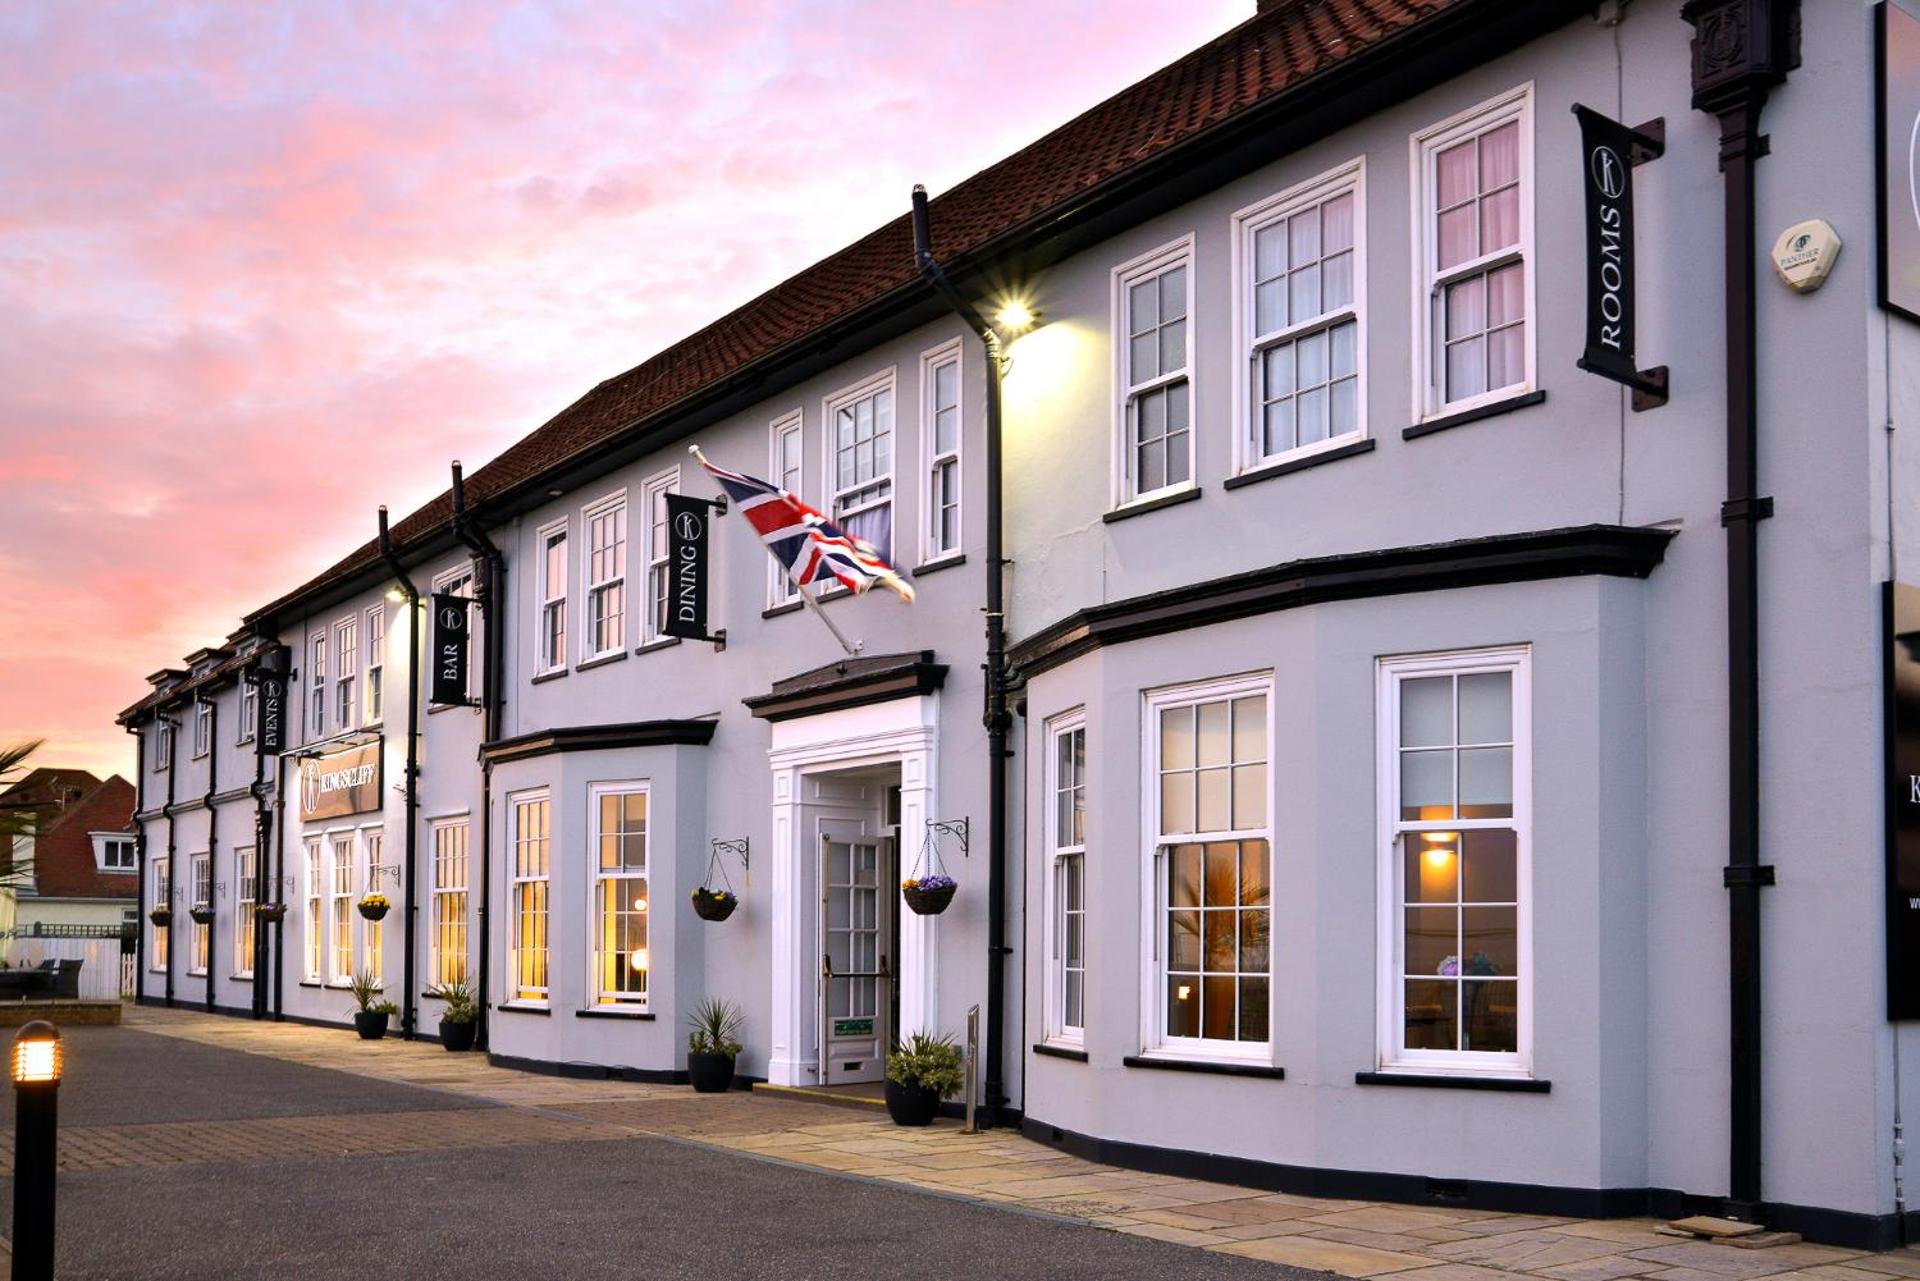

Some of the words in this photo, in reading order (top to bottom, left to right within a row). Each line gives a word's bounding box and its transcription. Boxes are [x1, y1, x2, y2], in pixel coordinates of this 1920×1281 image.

[1600, 205, 1622, 350] ROOMS
[679, 545, 697, 622] DINING
[443, 644, 458, 680] BAR
[265, 698, 278, 746] EVENTS
[320, 763, 376, 793] KINGSCLIFF
